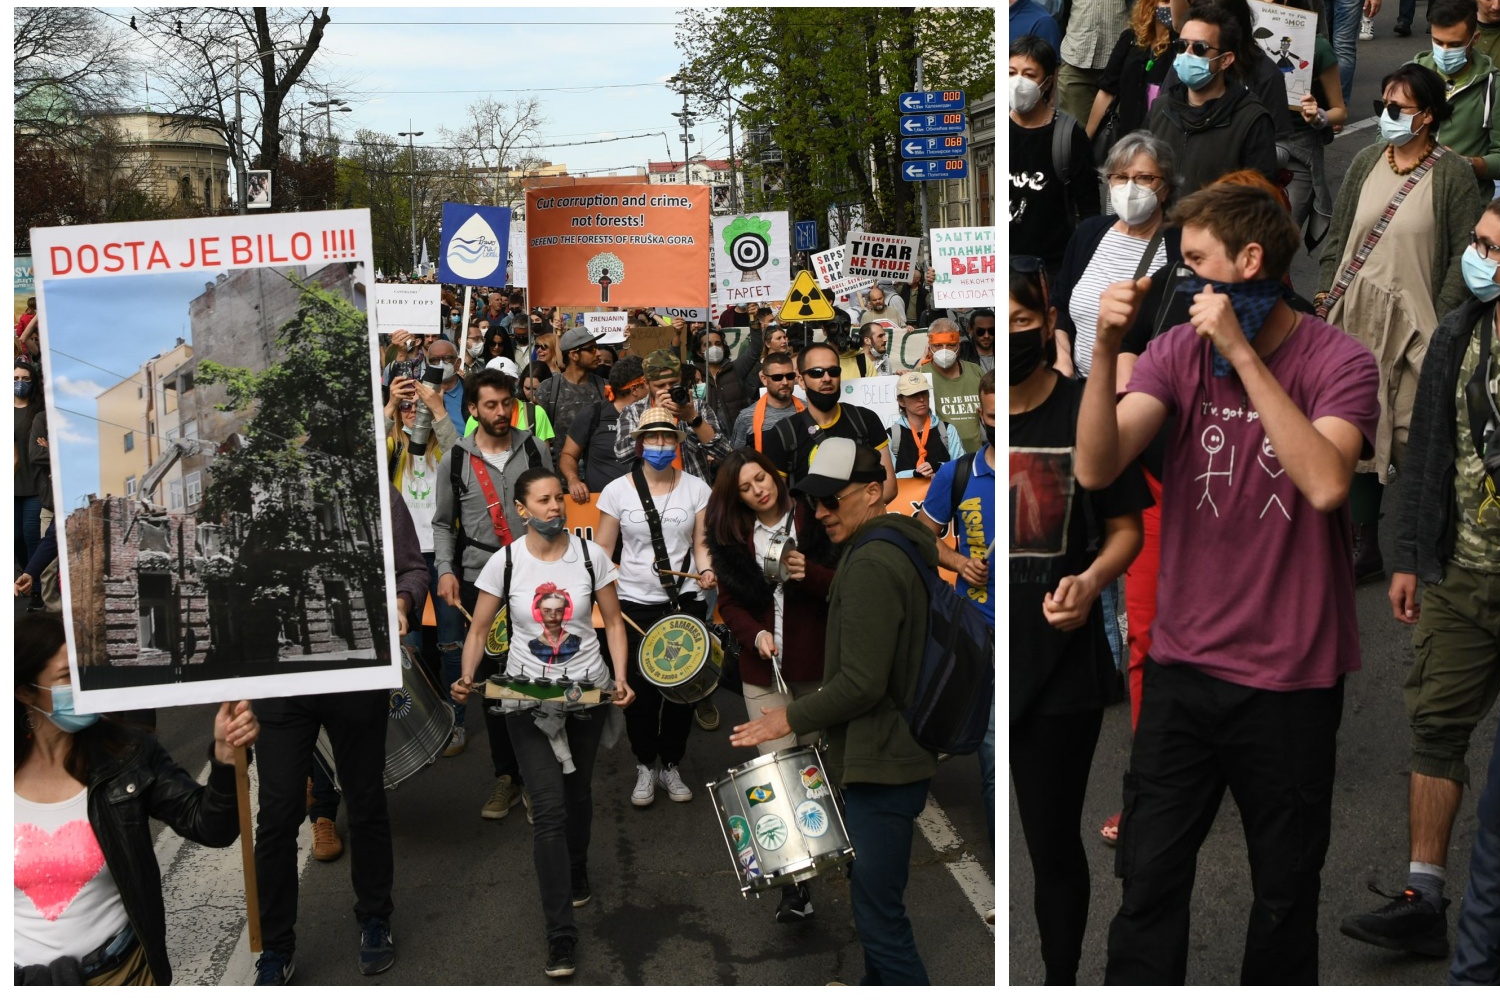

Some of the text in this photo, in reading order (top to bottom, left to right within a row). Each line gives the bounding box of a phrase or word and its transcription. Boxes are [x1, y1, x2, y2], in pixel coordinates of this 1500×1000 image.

[536, 193, 693, 210] Cut corruption and crime,
[571, 213, 645, 228] not forests!
[530, 233, 694, 248] DEFEND THE FORESTS OF FRUŠKA GORA
[935, 230, 995, 242] ЗАШТИТ
[50, 228, 357, 276] DOSTA JE BILO !!!!
[850, 240, 912, 260] TIGAR
[938, 244, 995, 257] ПЛАНИН
[850, 256, 910, 272] NE TRUJE
[849, 267, 909, 280] SVOJU DECU!
[726, 285, 771, 300] ТАРГЕТ
[590, 315, 625, 323] ZRENJANIN
[600, 324, 622, 333] ŽEDAN
